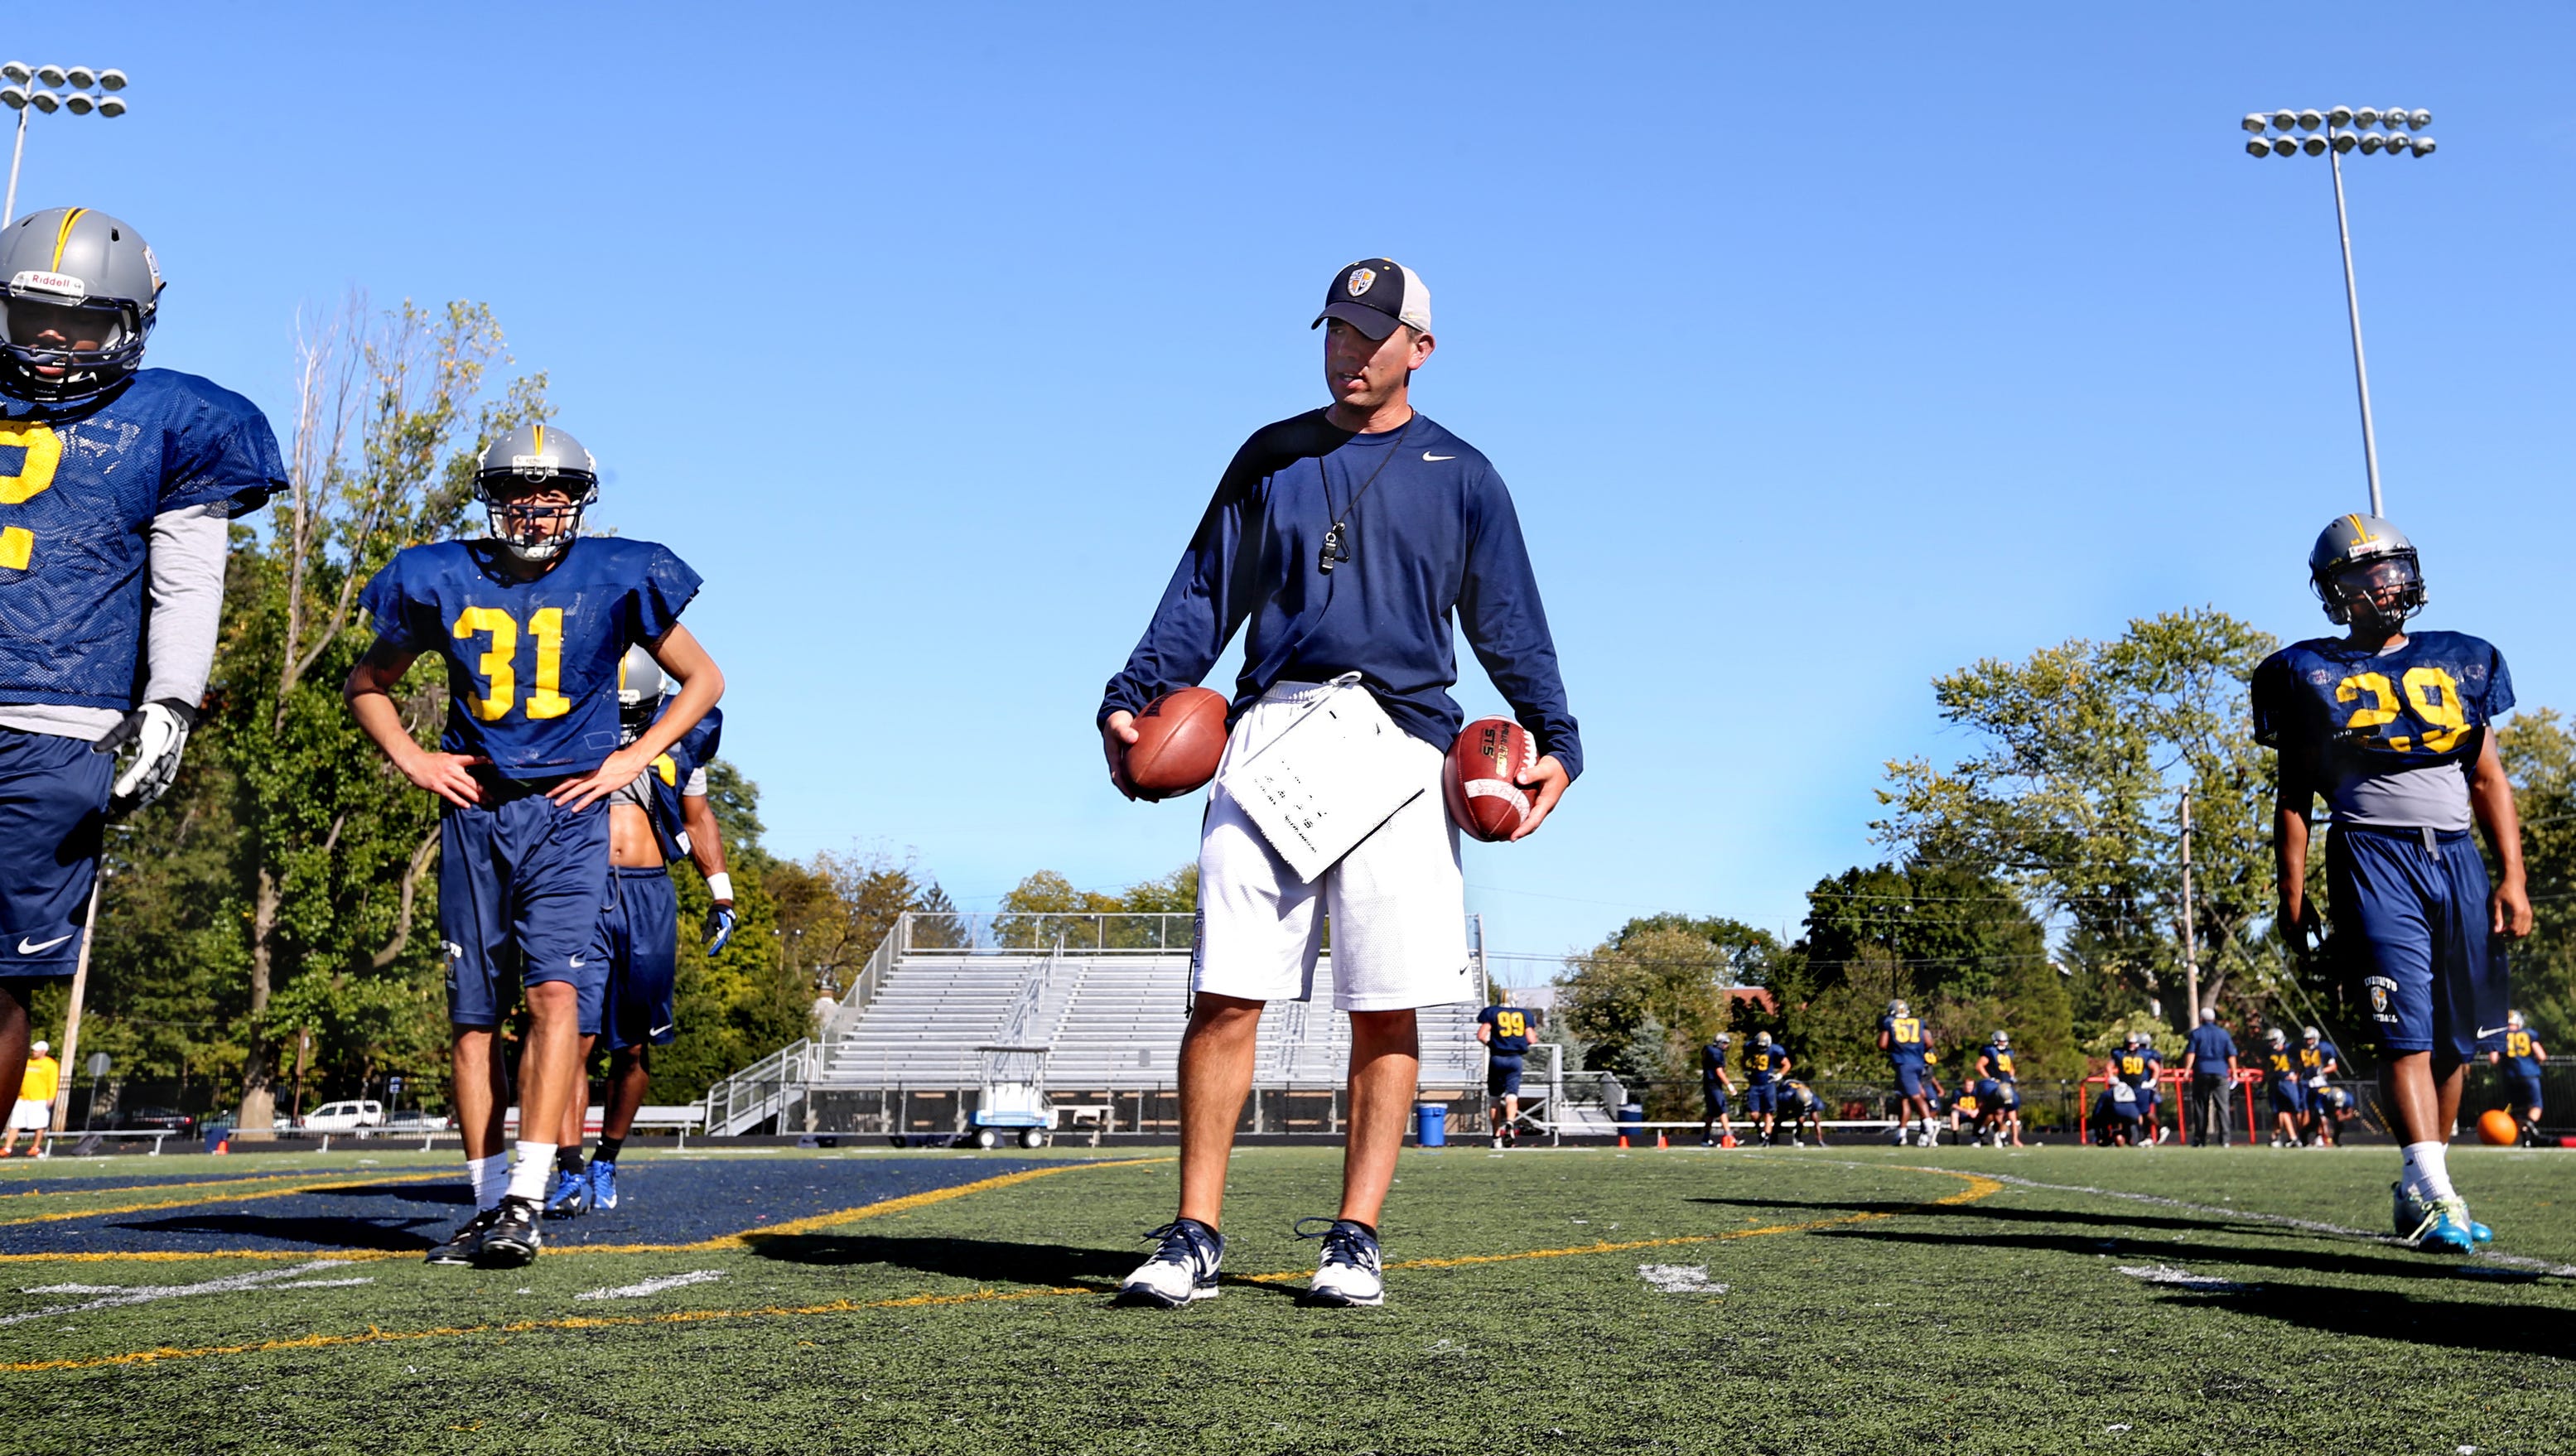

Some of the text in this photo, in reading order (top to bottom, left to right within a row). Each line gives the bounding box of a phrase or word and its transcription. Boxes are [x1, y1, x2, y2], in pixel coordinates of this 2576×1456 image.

[32, 274, 70, 288] Riddell
[453, 605, 571, 721] 31
[2335, 667, 2472, 755] 29
[2365, 976, 2398, 992] NIGHTS
[1497, 1010, 1525, 1037] 99
[1893, 1018, 1920, 1043] 67
